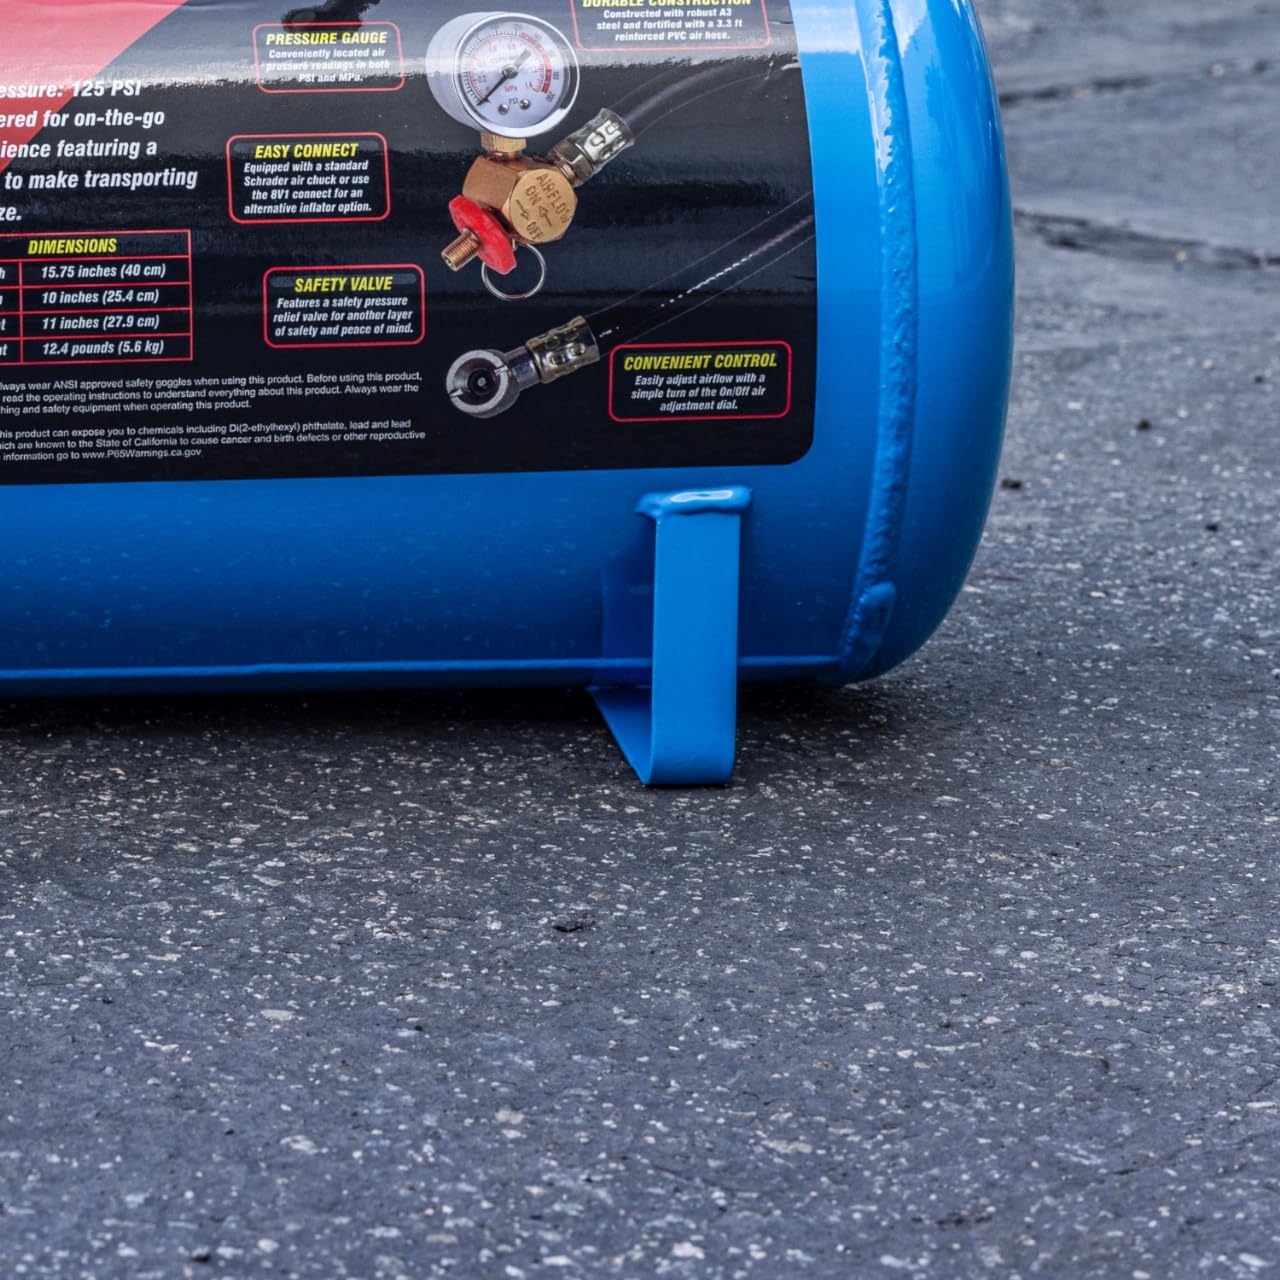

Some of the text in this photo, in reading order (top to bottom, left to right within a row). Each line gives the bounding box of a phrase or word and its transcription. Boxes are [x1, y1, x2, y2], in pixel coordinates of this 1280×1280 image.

[603, 7, 732, 19] Constructed with robust A3
[597, 18, 743, 30] steel and fortified with a 3.3 ft
[266, 31, 387, 45] PRESSURE GAUGE
[614, 30, 730, 41] reinforced PVC air hose.
[268, 47, 385, 59] Conveniently located air
[310, 60, 355, 71] readings
[356, 60, 366, 69] in
[368, 59, 390, 69] both
[298, 72, 364, 82] PSI and MPa.
[72, 81, 105, 97] 125
[110, 81, 145, 96] PSI
[42, 109, 70, 127] for
[74, 108, 164, 129] on-the-go
[56, 138, 140, 160] featuring
[146, 141, 157, 154] a
[255, 143, 359, 158] EASY CONNECT
[244, 159, 369, 174] Equipped with a standard
[4, 171, 23, 190] to
[28, 170, 78, 188] make
[84, 168, 197, 190] transporting
[244, 174, 369, 186] Schrader air chuck or use
[251, 188, 362, 200] the 8V1 connect for an
[244, 201, 371, 214] alternative inflator option.
[29, 238, 116, 253] DIMENSIONS
[42, 263, 166, 278] 15.75 inches (40 cm)
[295, 276, 391, 292] SAFETY VALVE
[42, 288, 159, 304] 10 inches (25.4 cm)
[276, 296, 407, 309] Features a safety pressure
[42, 314, 160, 330] 11 inches (27.9 cm)
[272, 309, 412, 322] relief valve for another layer
[275, 322, 413, 337] of safety and peace of mind.
[43, 339, 164, 356] 12.4 pounds (5.6 kg)
[624, 353, 775, 369] CONVENIENT CONTROL
[52, 379, 78, 389] ANSI
[80, 379, 123, 390] approved
[125, 377, 154, 389] safety
[155, 377, 192, 388] goggles
[194, 376, 220, 385] when
[221, 375, 246, 387] using
[248, 375, 265, 384] this
[267, 374, 304, 386] product.
[307, 373, 337, 383] Before
[339, 372, 364, 384] using
[366, 371, 382, 381] this
[385, 371, 422, 383] product,
[635, 373, 765, 387] Easily adjust airflow with a
[631, 385, 766, 400] simple turn of the On/Off air
[660, 399, 738, 412] adjustment dial.
[3, 451, 54, 461] information
[56, 452, 68, 461] go
[71, 451, 80, 459] to
[82, 448, 202, 458] www.P65Warnings.ca.gov
